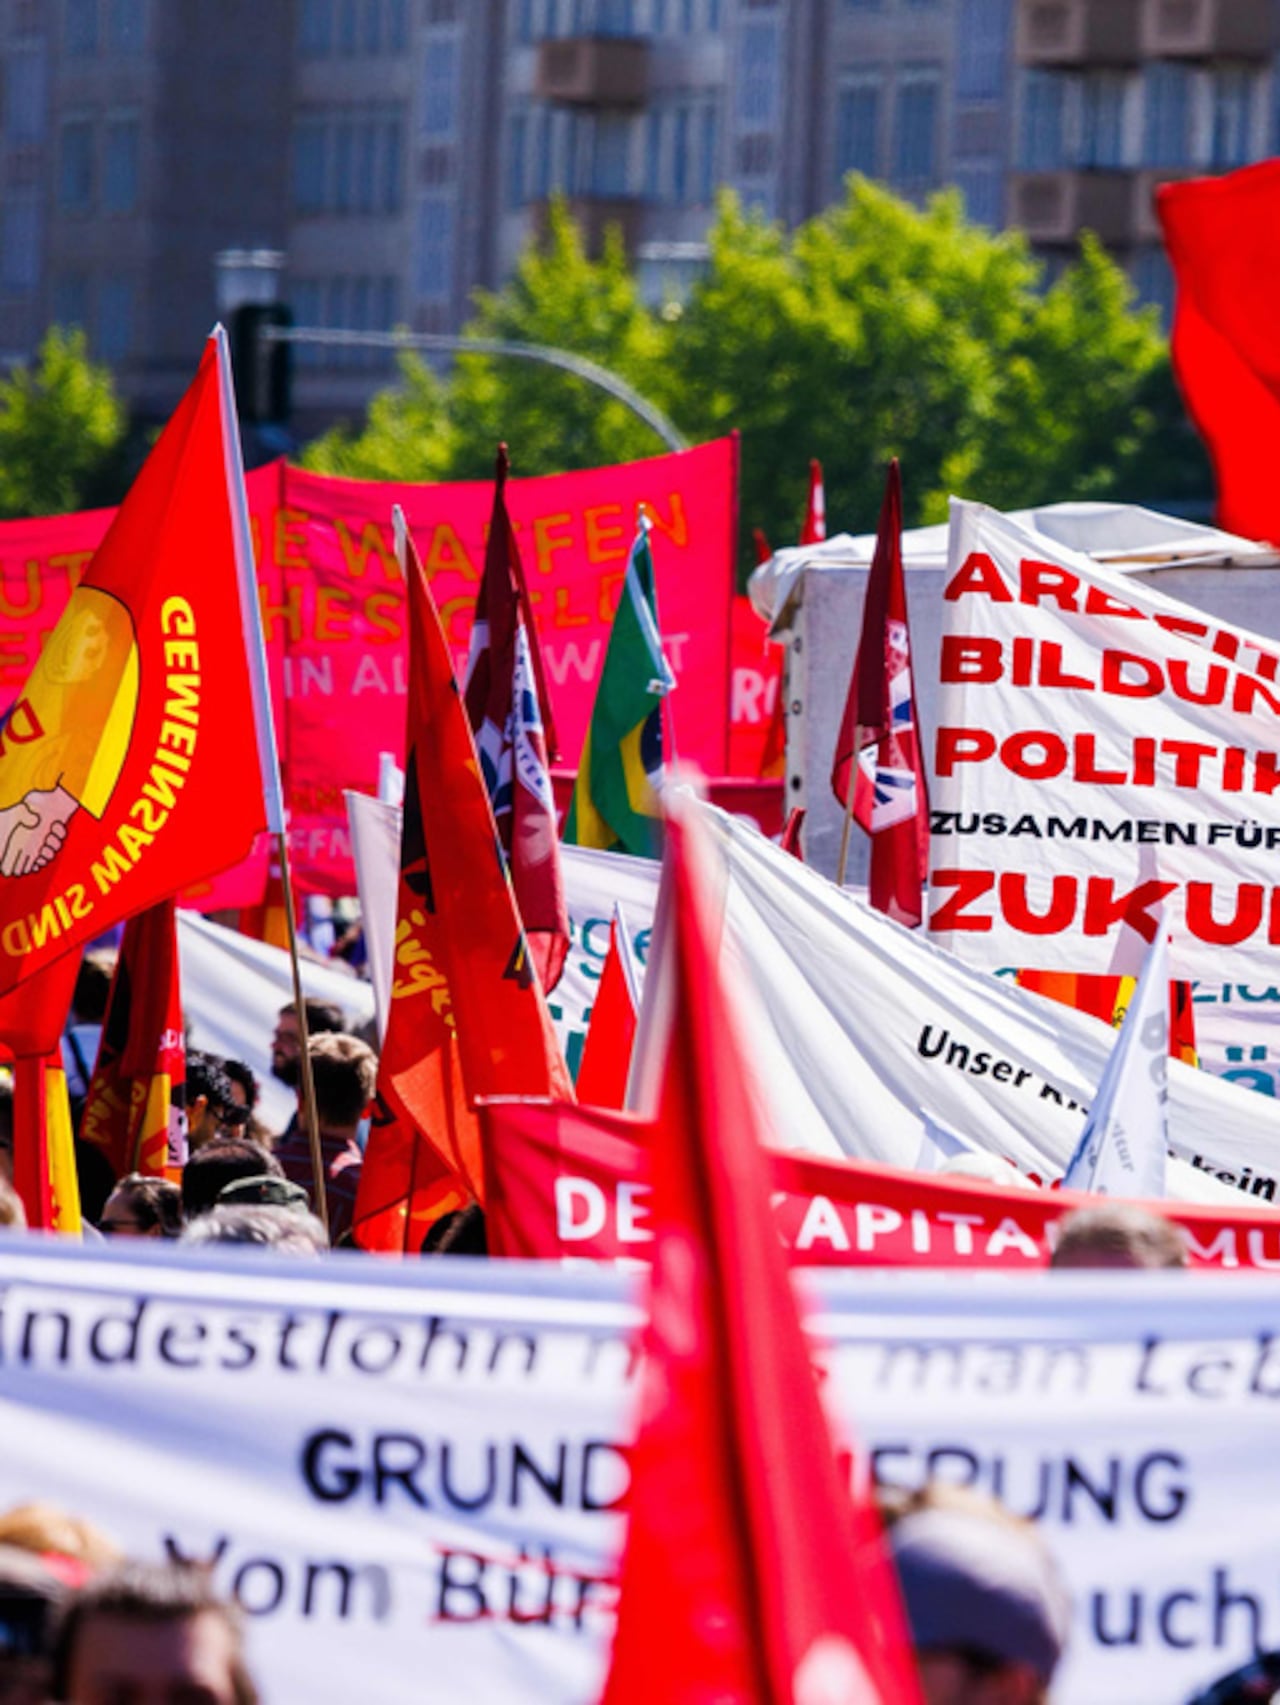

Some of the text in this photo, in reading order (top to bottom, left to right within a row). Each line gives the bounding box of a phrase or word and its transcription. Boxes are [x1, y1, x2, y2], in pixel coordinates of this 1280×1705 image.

[335, 494, 689, 582] WAFEN
[930, 811, 1198, 846] ZUSAMMEN
[917, 1024, 1032, 1087] Unser
[0, 1296, 538, 1374] ndestlohn
